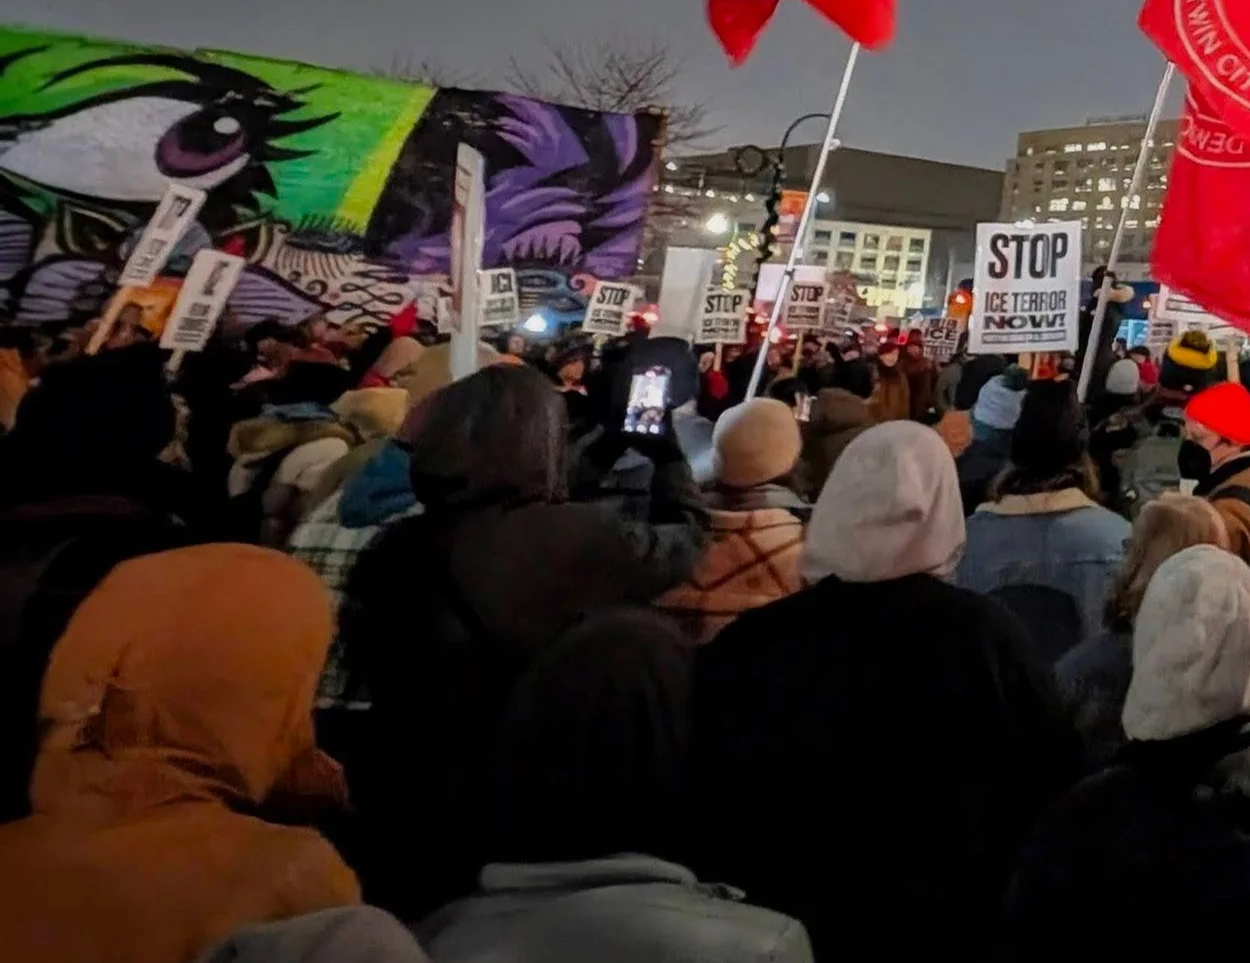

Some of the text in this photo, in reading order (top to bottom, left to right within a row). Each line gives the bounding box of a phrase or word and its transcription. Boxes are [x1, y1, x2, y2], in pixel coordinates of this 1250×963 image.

[987, 232, 1069, 279] STOP
[597, 285, 631, 305] STOP
[791, 284, 824, 302] STOP
[984, 290, 1067, 313] ICE TERROR
[704, 294, 743, 314] STOP
[982, 312, 1067, 330] NOW!
